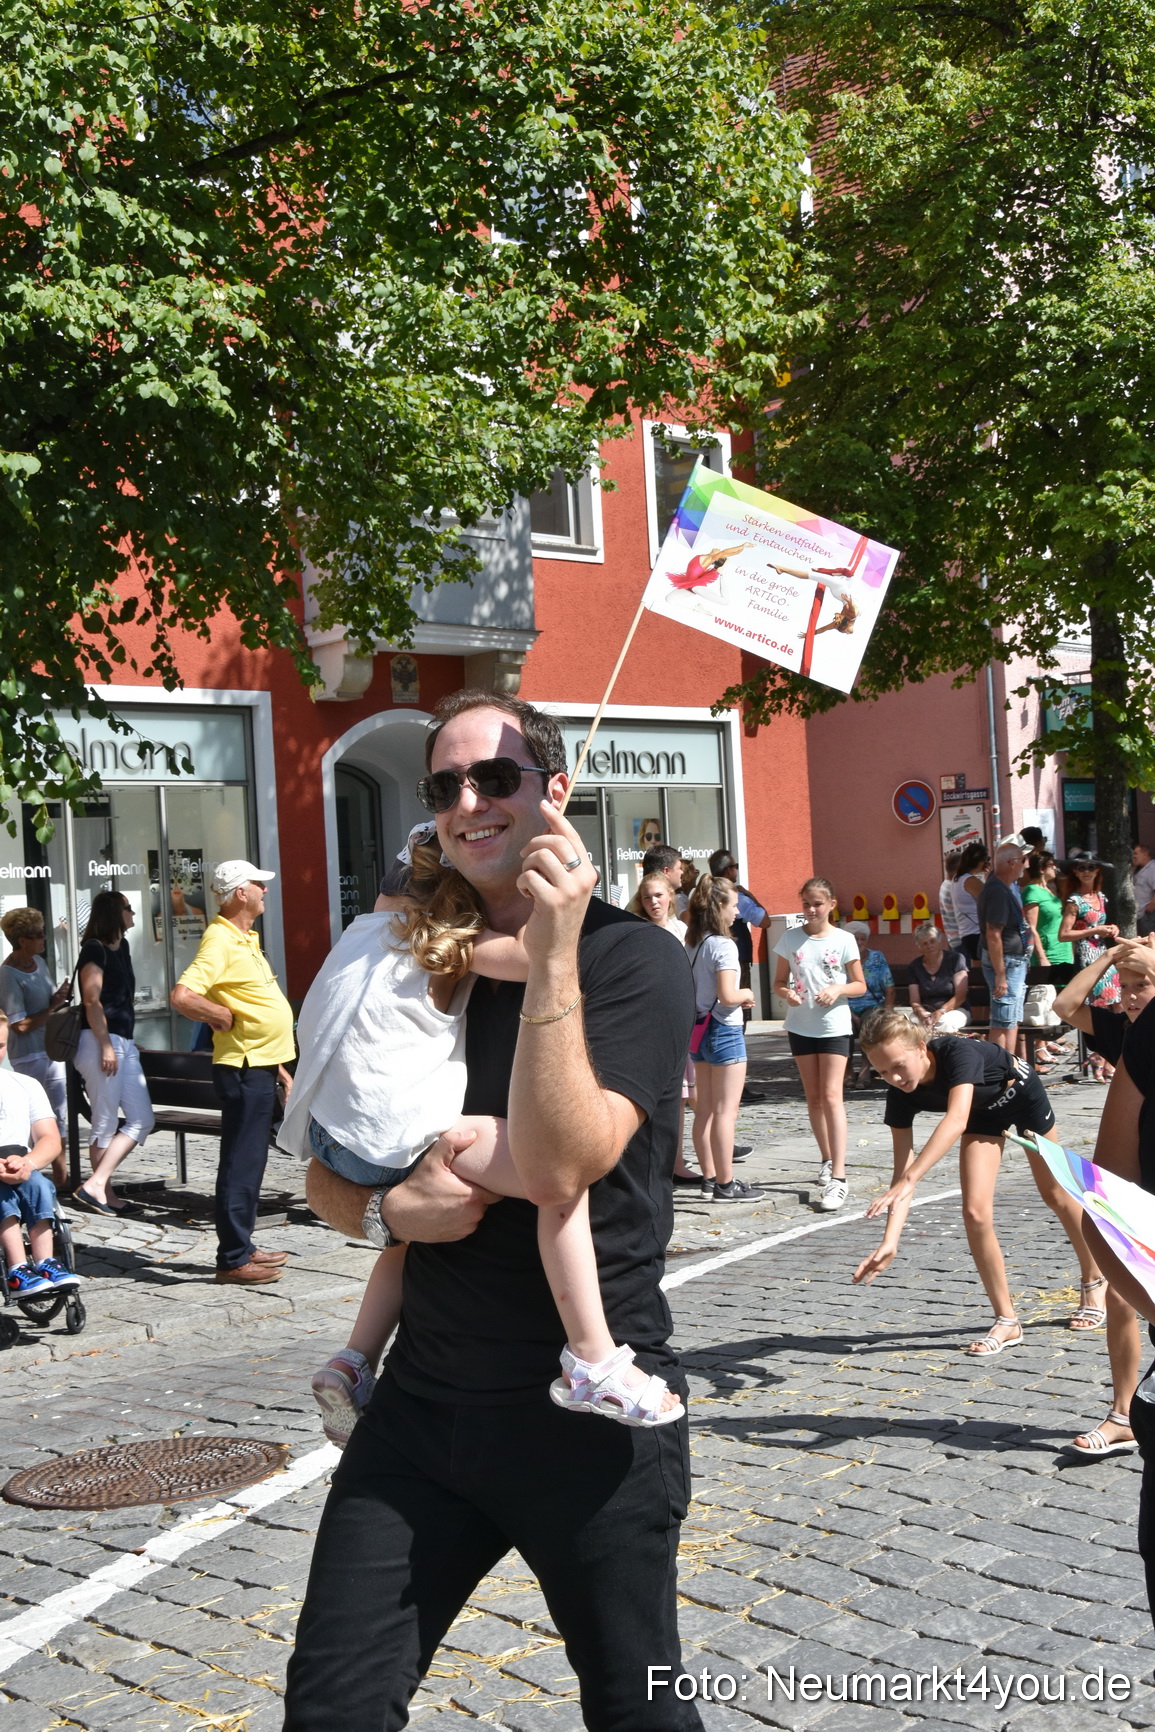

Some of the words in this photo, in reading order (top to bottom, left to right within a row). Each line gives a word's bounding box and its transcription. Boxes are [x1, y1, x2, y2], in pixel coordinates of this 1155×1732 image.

[725, 523, 750, 537] und
[752, 532, 814, 564] Eintauchen
[742, 513, 784, 537] Stärken
[784, 533, 833, 559] entfalten
[735, 566, 748, 577] in
[749, 572, 768, 584] die
[768, 581, 800, 598] große
[747, 599, 790, 622] Familie
[714, 616, 795, 656] www.artico.de
[576, 739, 687, 776] fielmann
[88, 860, 147, 876] fielmann
[616, 847, 647, 861] fielma
[0, 863, 52, 879] elmann
